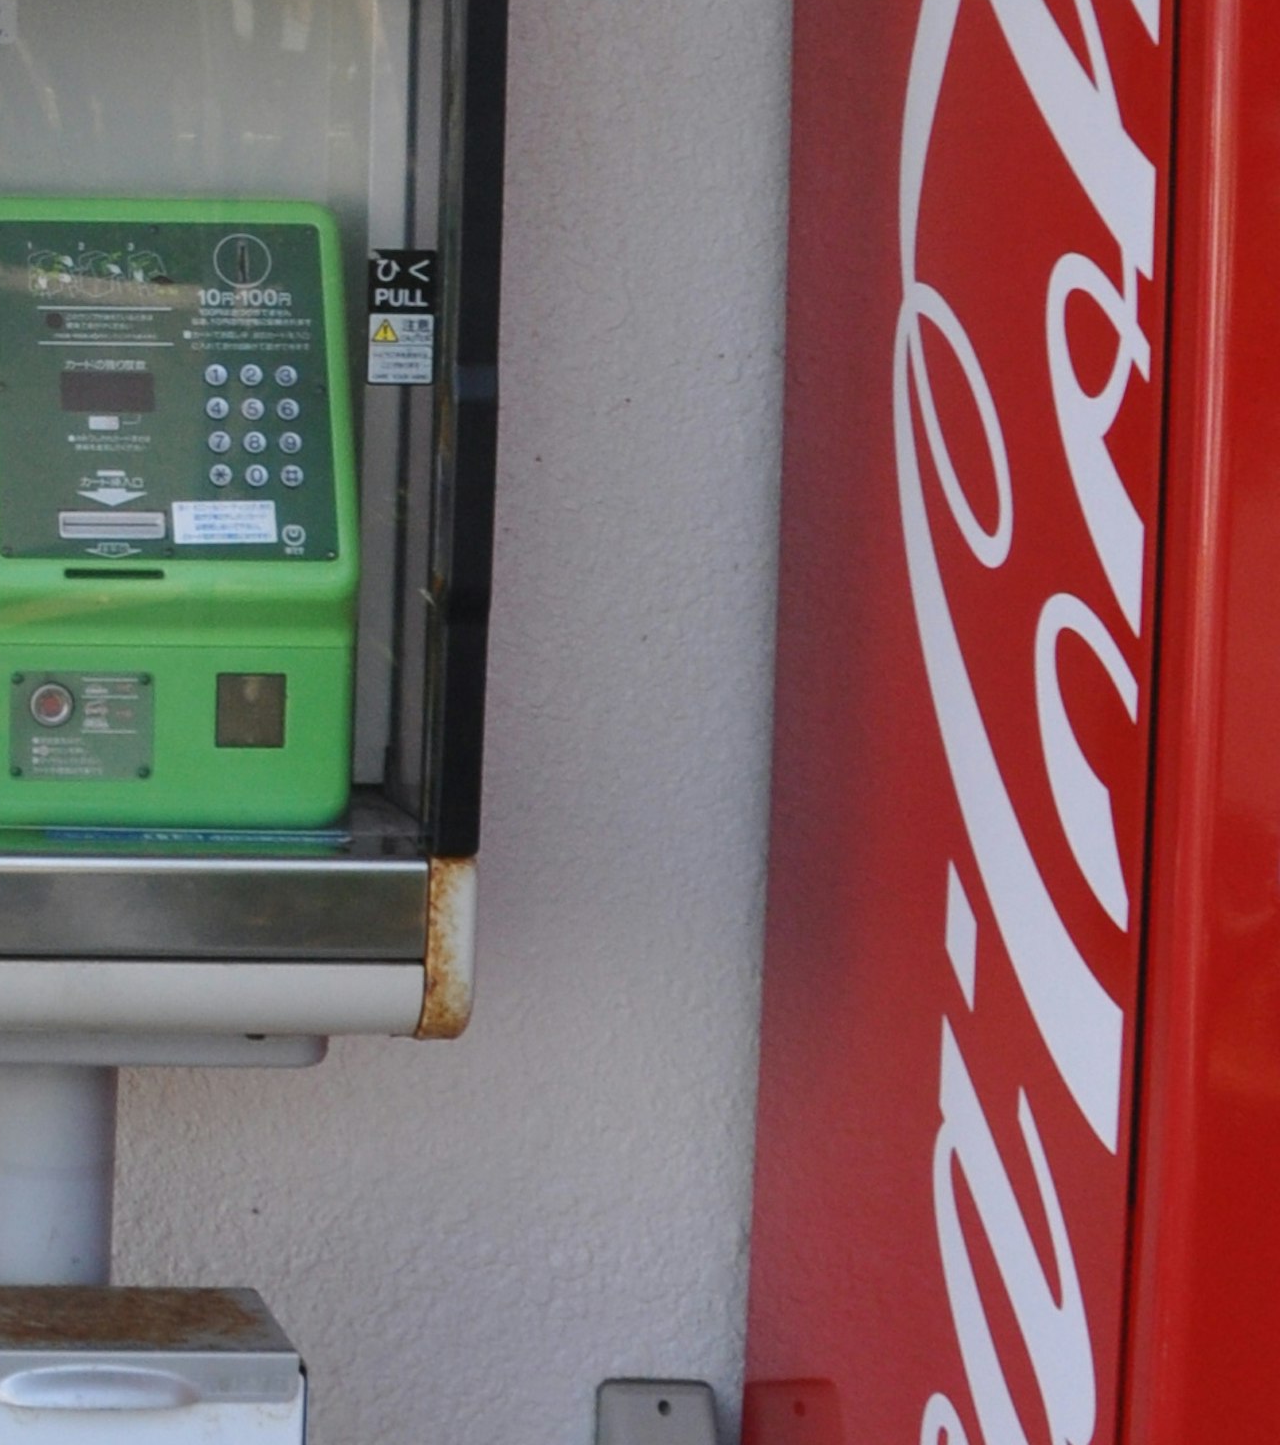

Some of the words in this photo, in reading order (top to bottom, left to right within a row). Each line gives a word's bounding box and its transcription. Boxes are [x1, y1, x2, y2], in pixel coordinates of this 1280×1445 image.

[376, 259, 431, 282] ひく
[375, 289, 428, 307] PULL
[246, 368, 256, 383] 2
[280, 369, 291, 384] 3
[211, 402, 221, 415] 4
[248, 401, 259, 417] 5
[282, 401, 294, 417] 6
[215, 434, 225, 449] 7
[249, 434, 260, 450] 8
[284, 435, 297, 450] 9
[251, 467, 263, 483] 0
